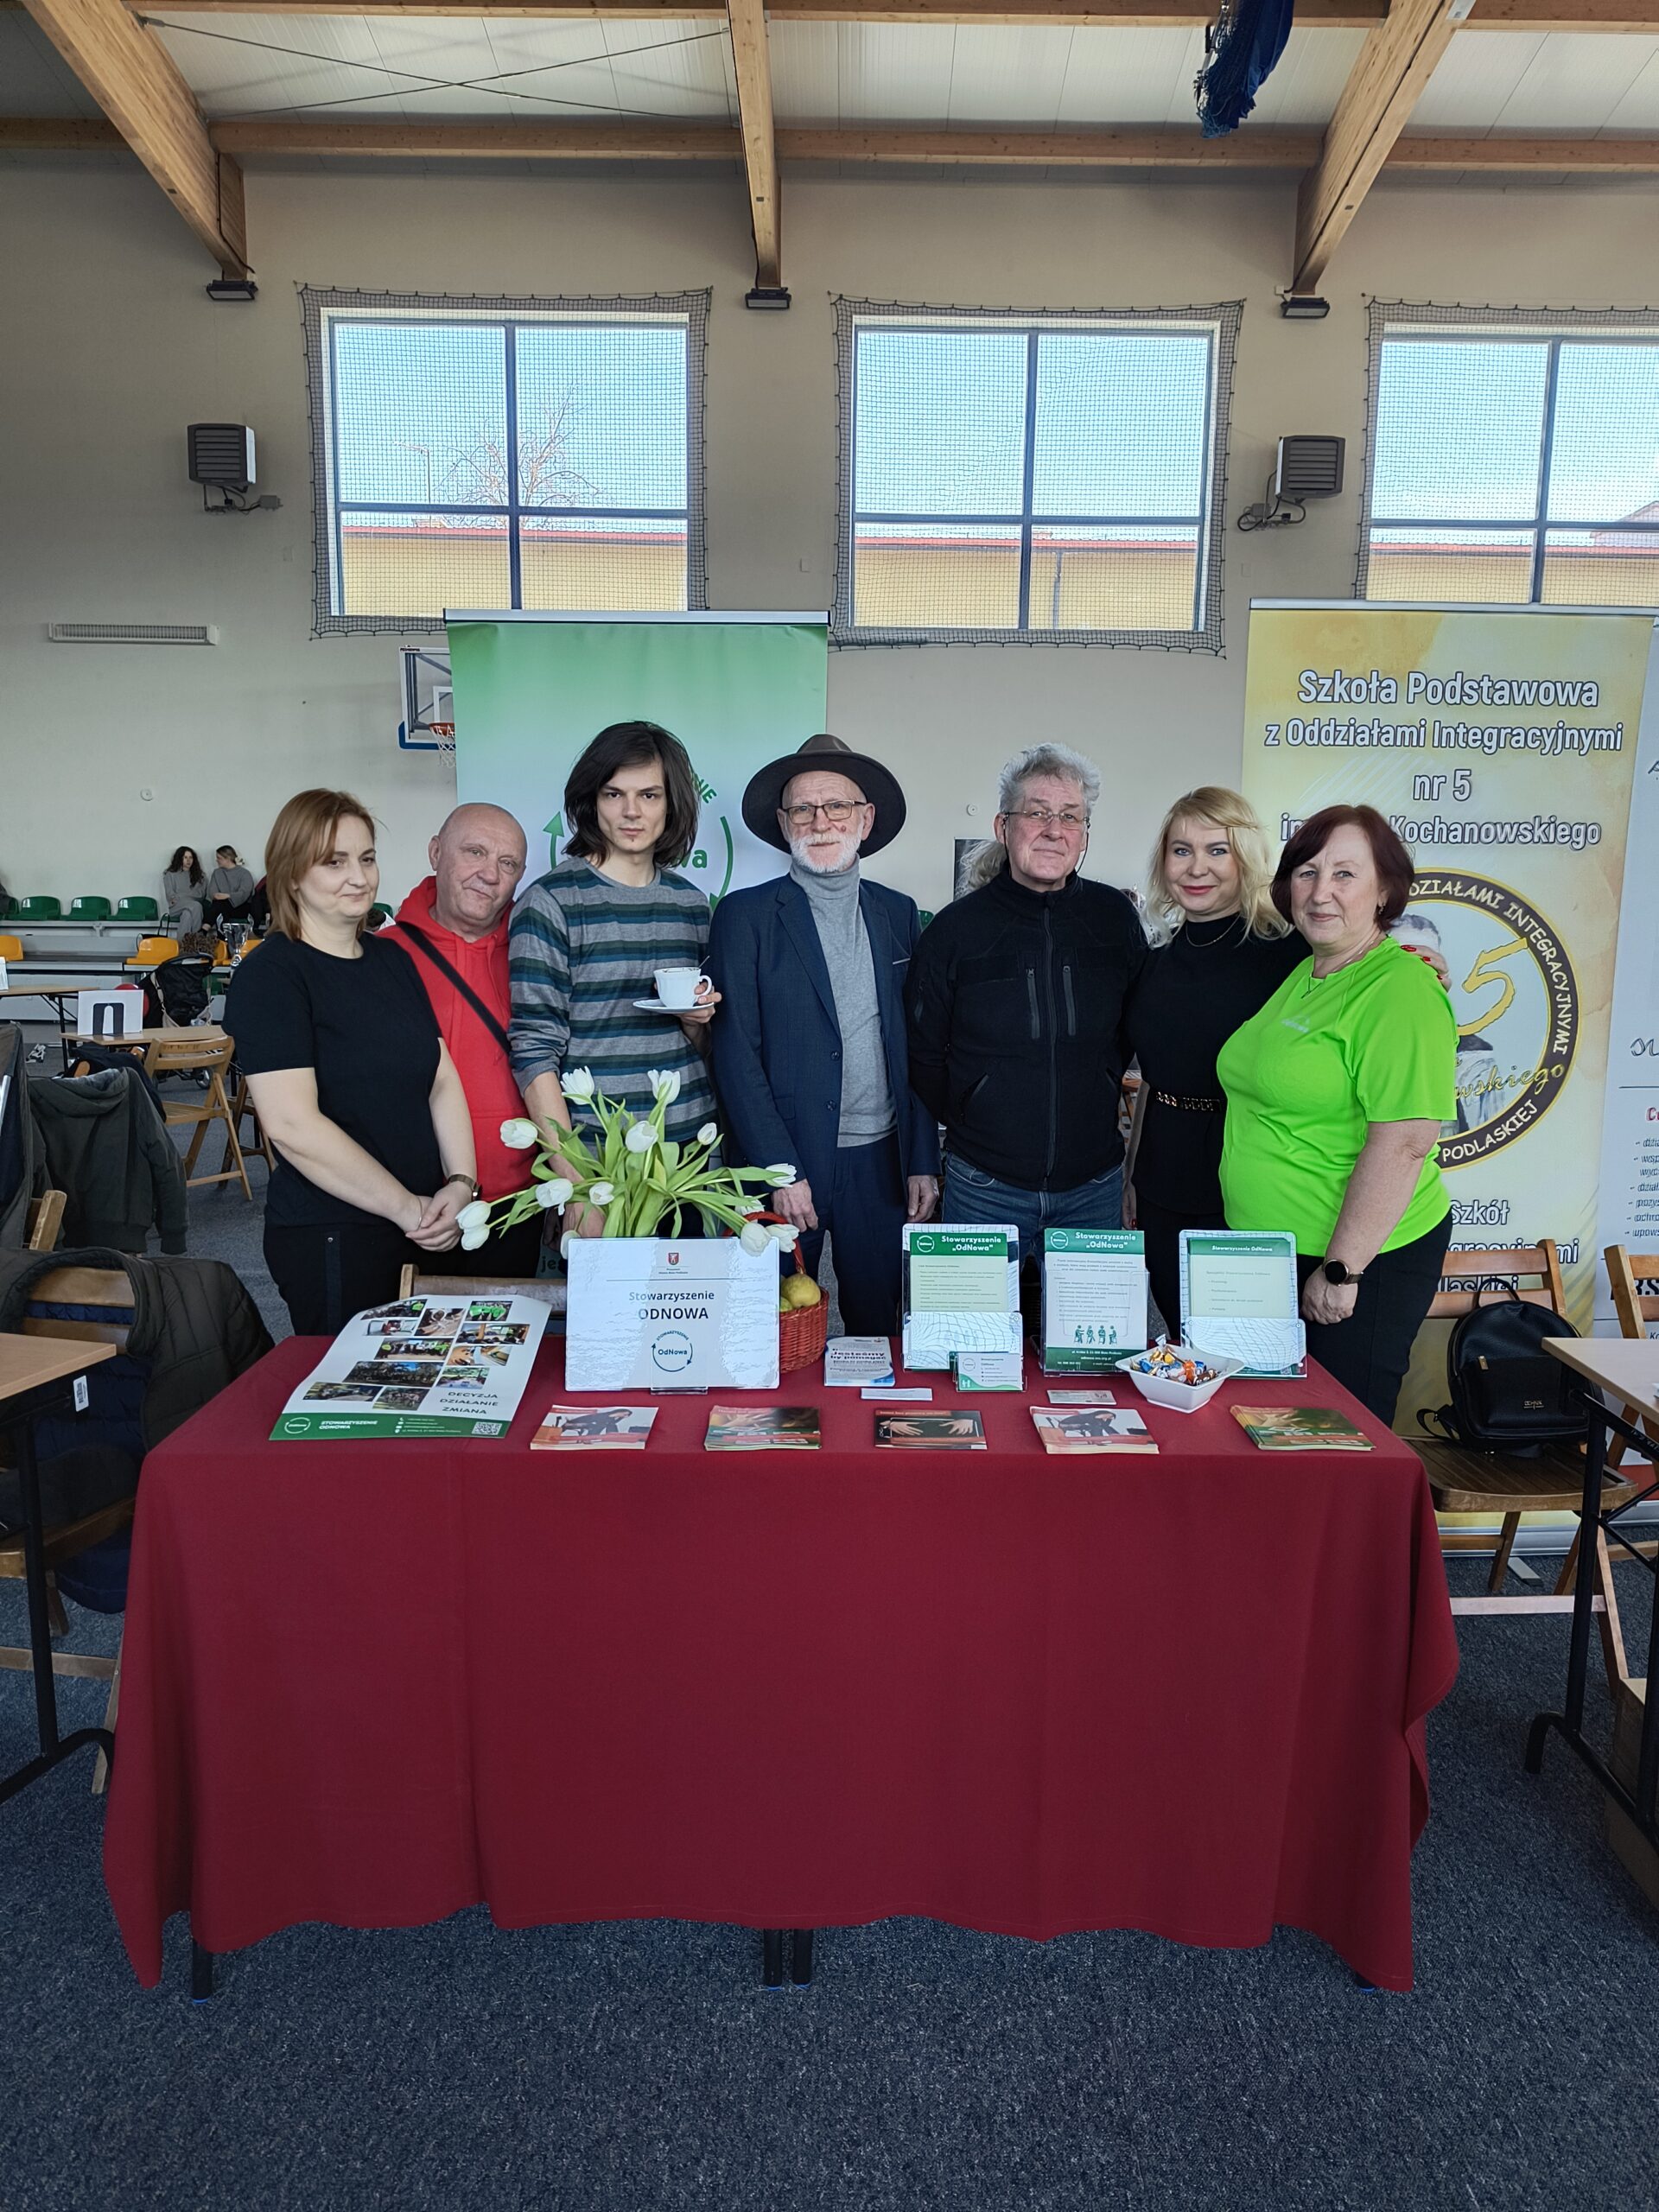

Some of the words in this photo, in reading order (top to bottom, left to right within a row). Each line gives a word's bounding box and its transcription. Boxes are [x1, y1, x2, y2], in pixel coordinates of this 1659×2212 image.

[1298, 670, 1397, 704] Szkoła
[1407, 671, 1599, 708] Podstawowa
[1264, 724, 1281, 747] z
[1286, 717, 1426, 748] Oddziałami
[1433, 720, 1623, 755] Integracyjnymi
[1413, 773, 1446, 802] nr
[1452, 769, 1471, 802] 5
[1389, 815, 1602, 851] Kochanowskiego
[1503, 901, 1573, 1056] INTEGRACYJNYMI
[1442, 1099, 1538, 1162] PODLASKIEJ
[1451, 1199, 1510, 1225] Szkół
[942, 1236, 1001, 1244] Stowarzyszenie
[1076, 1231, 1136, 1243] Stowarzyszenie
[629, 1290, 715, 1302] Stowarzyszenie
[639, 1307, 709, 1319] ODNOWA
[440, 1398, 499, 1407] DZIAŁANIE
[448, 1390, 499, 1399] DECYZJA
